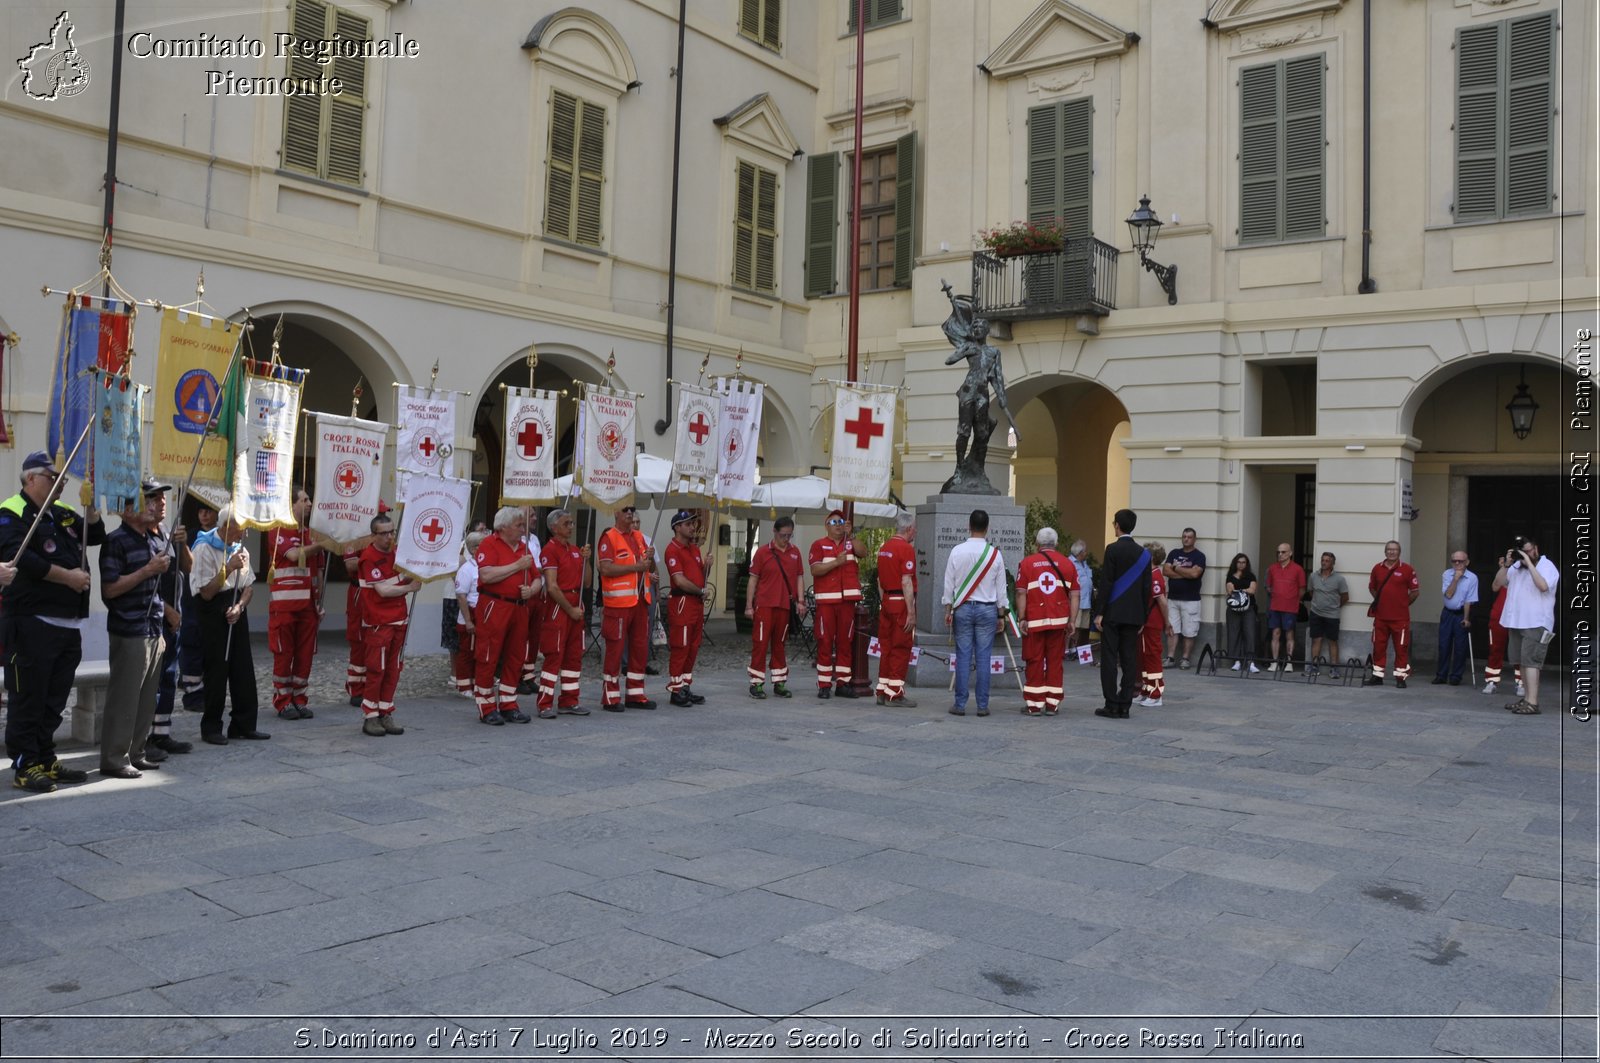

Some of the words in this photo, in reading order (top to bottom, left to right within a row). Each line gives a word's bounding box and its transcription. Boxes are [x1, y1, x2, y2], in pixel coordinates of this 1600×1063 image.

[201, 342, 231, 355] COMUNA
[591, 394, 613, 405] CROCE
[615, 398, 633, 409] ROSSA
[407, 404, 427, 412] CROCE
[598, 405, 627, 417] ITALIANA
[323, 433, 352, 443] CROCE
[355, 437, 381, 449] ROSSA
[332, 444, 371, 457] ITALIANA
[160, 453, 175, 462] SAN
[593, 469, 629, 478] MONTIGLIO
[589, 477, 632, 487] MONFERRATO
[318, 502, 348, 511] COMITATO
[351, 504, 375, 516] LOCALE
[335, 512, 361, 522] CANELLI
